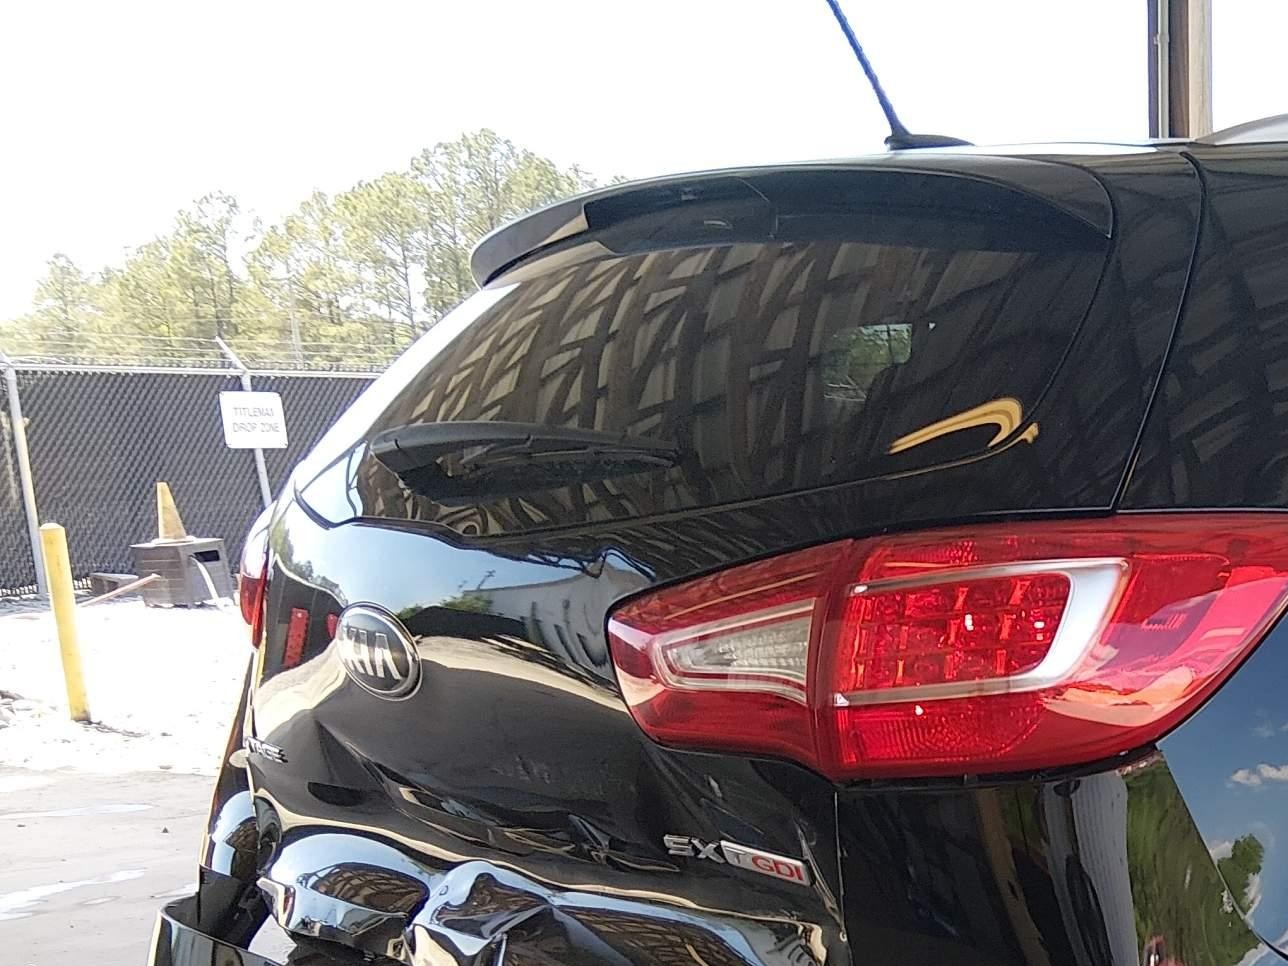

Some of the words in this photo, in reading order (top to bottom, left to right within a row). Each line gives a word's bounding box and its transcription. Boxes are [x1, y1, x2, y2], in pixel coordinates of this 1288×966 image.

[232, 422, 257, 433] DROP
[260, 422, 280, 433] ZONE
[342, 626, 402, 680] KIA
